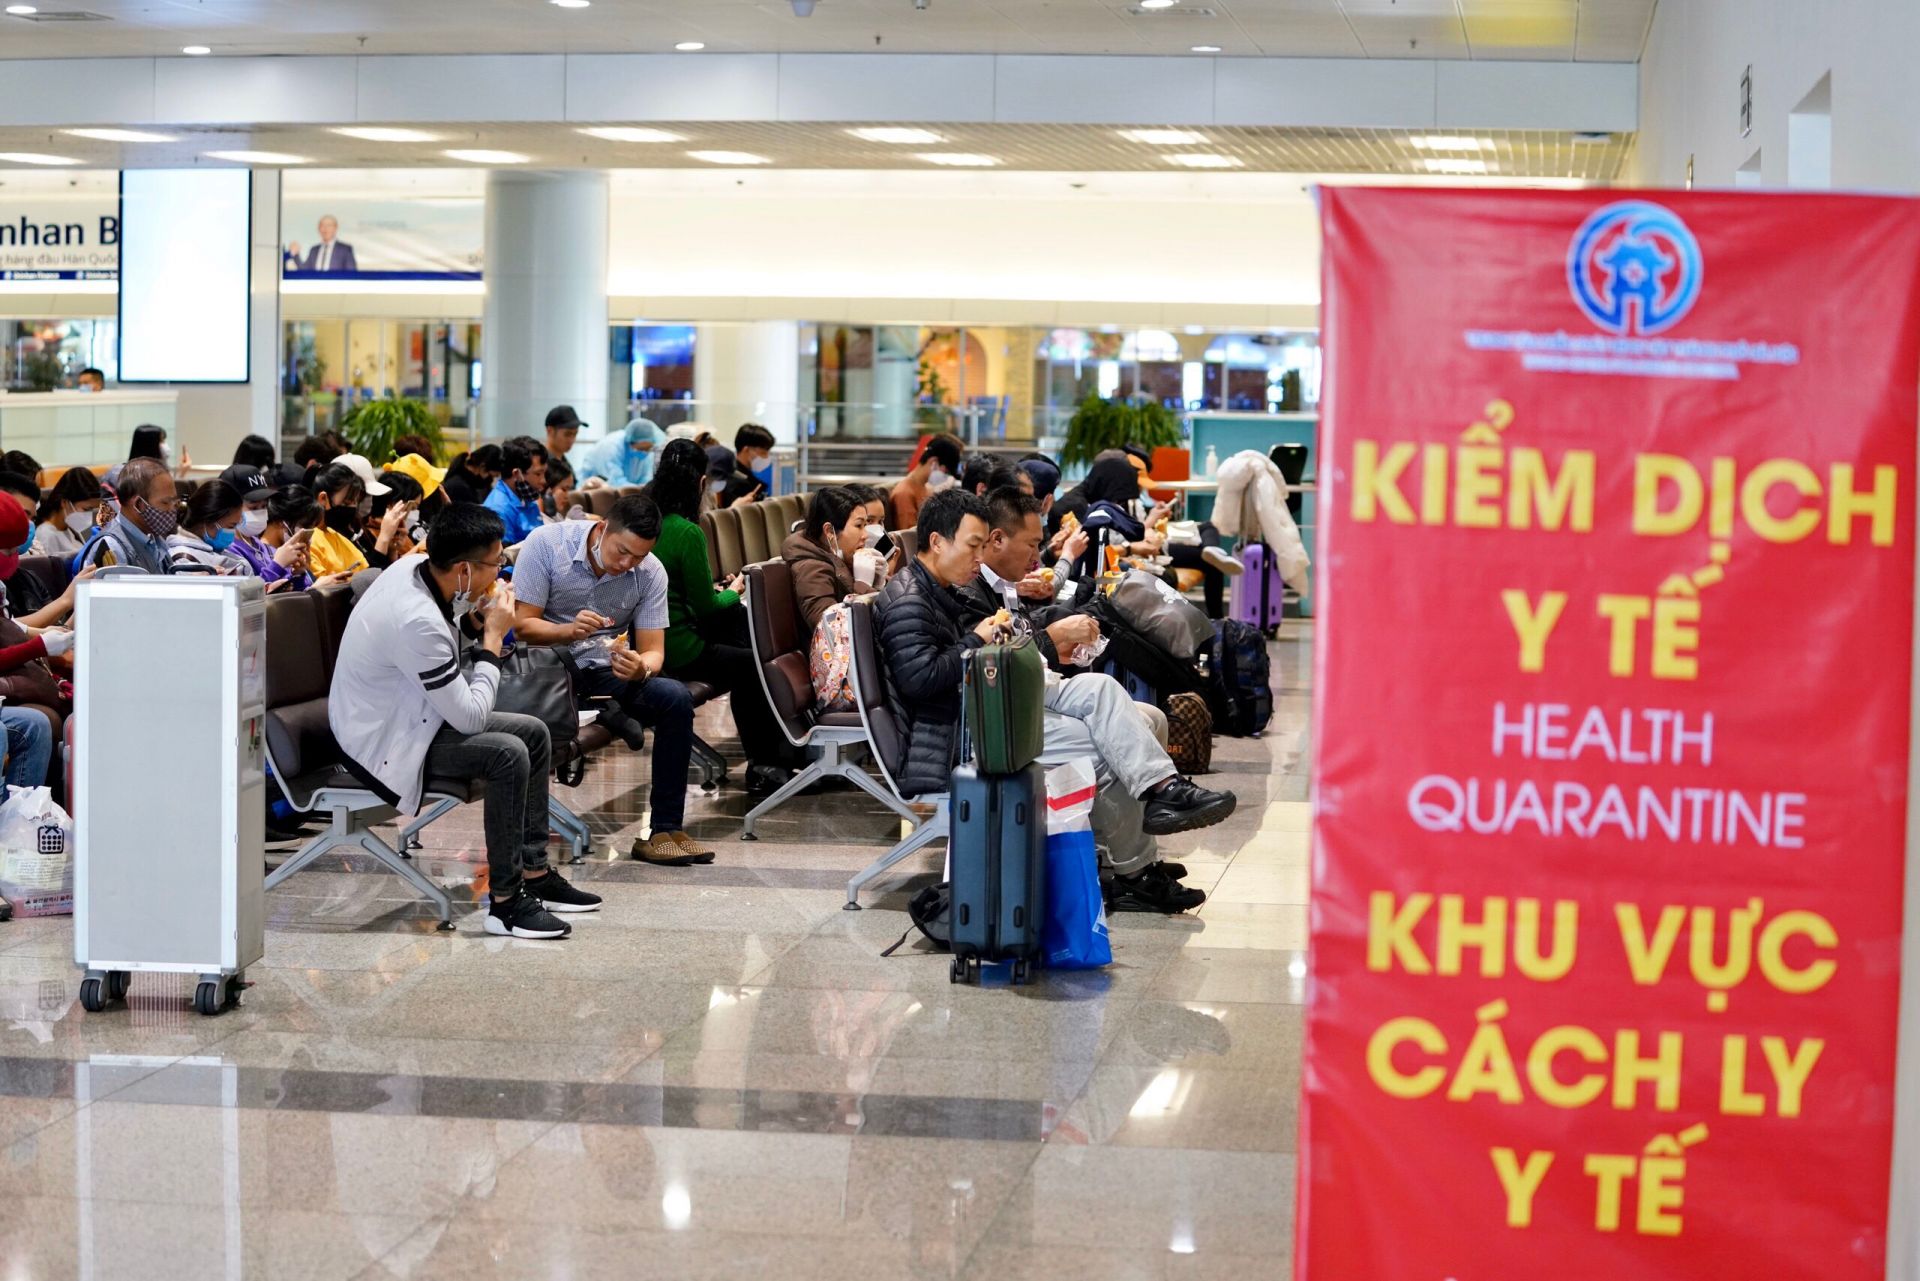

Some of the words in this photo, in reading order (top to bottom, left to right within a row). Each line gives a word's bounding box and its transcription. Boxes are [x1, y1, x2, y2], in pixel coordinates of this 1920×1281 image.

[1351, 401, 1596, 532] KIỂM
[1631, 453, 1898, 564] DỊCH
[1502, 590, 1568, 673] Y
[1597, 563, 1724, 680] TẾ
[1491, 701, 1714, 766] HEALTH
[1406, 773, 1807, 848] QUARANTINE
[1366, 891, 1579, 982] KHU
[1614, 897, 1839, 1013] VỰC
[1366, 998, 1684, 1112] CÁCH
[1719, 1034, 1825, 1118] LY
[1490, 1147, 1555, 1228] Y
[1583, 1122, 1708, 1236] TẾ
